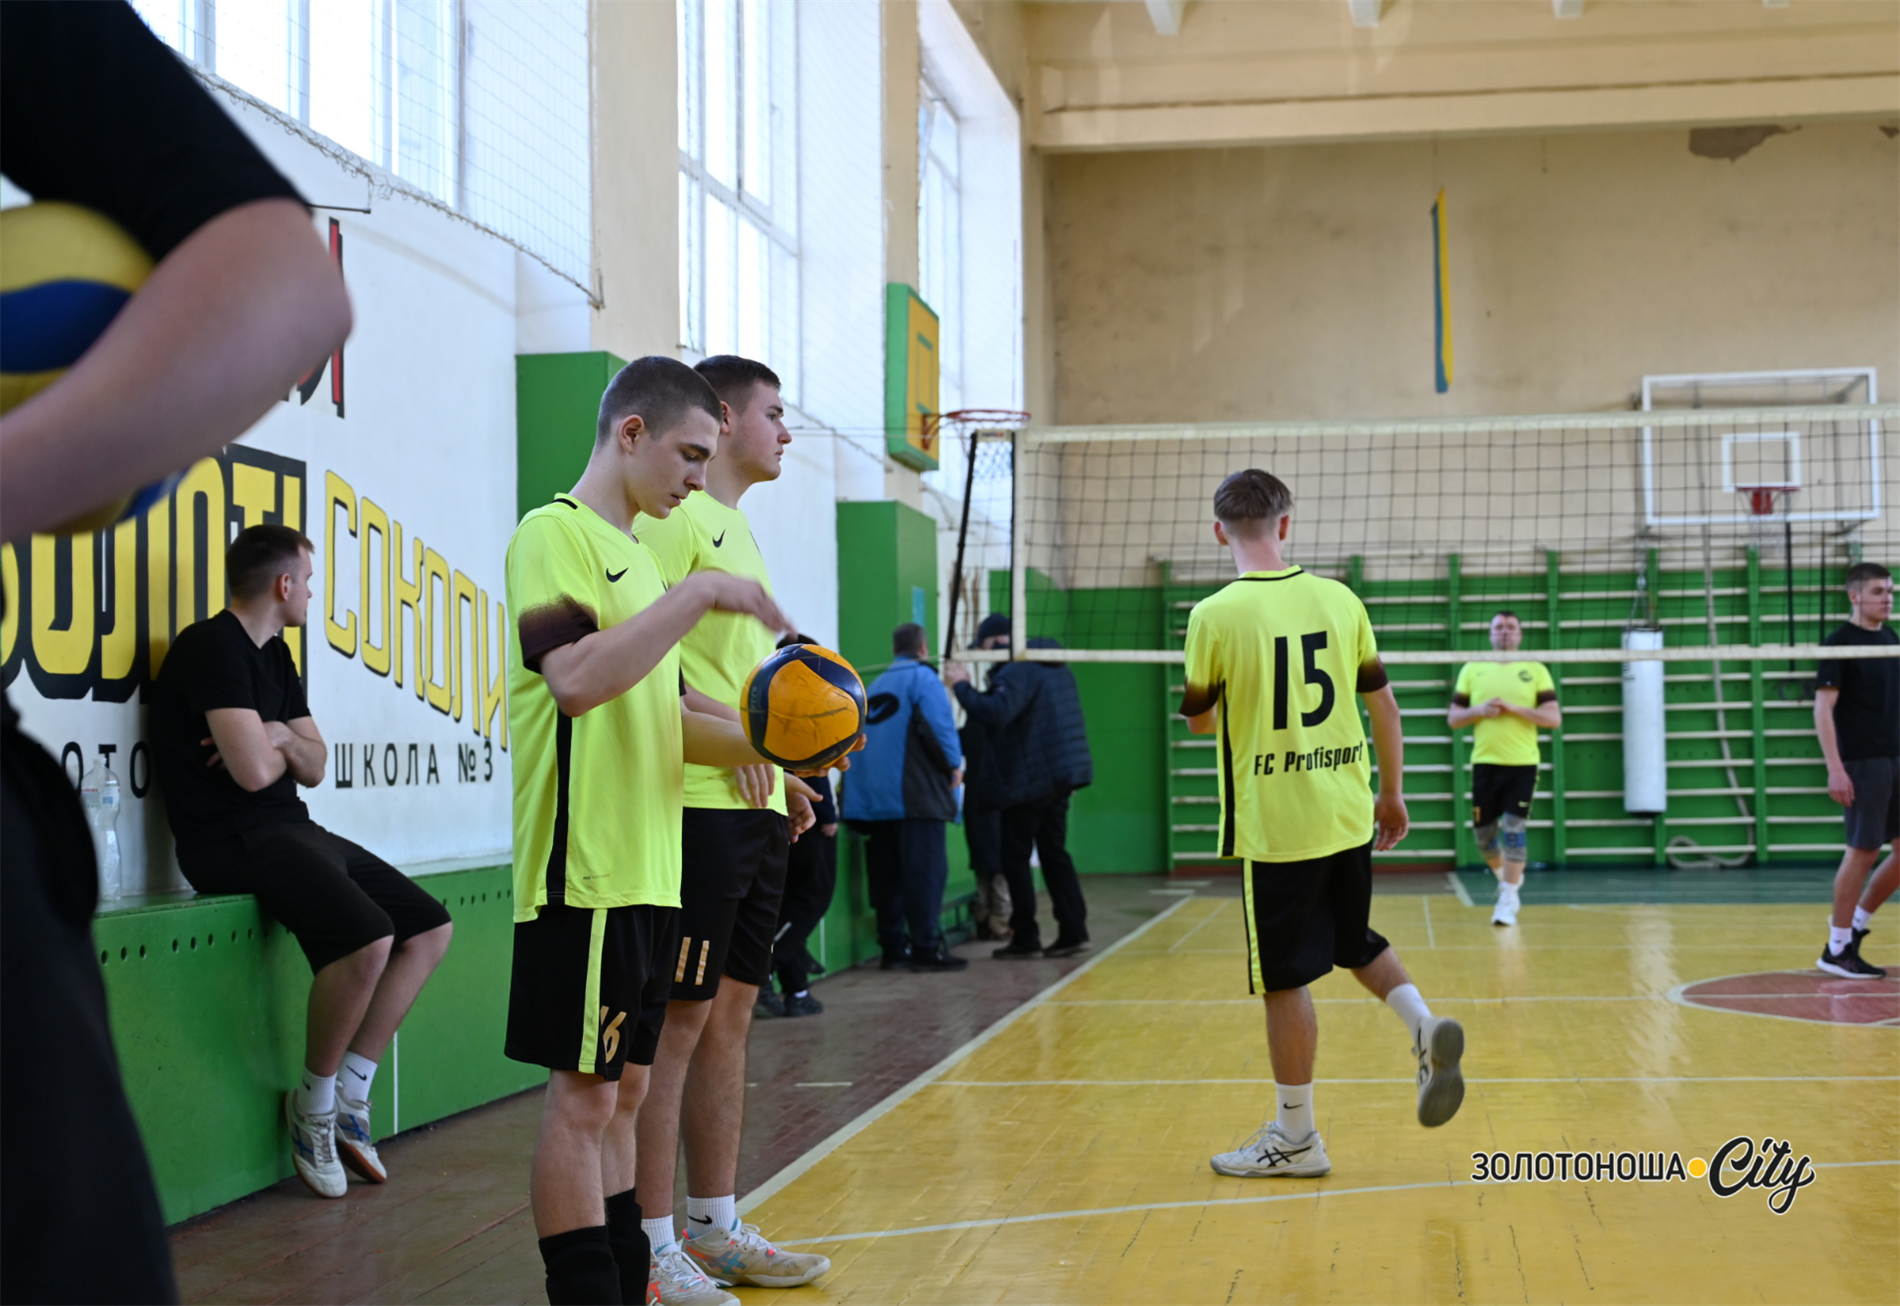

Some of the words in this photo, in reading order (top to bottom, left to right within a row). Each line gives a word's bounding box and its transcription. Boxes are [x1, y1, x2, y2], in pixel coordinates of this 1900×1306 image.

[324, 469, 507, 753] СОКОЛИ
[1273, 631, 1335, 731] 15
[335, 742, 440, 789] ШКОЛА
[1254, 750, 1276, 776] FC
[1283, 740, 1363, 773] Profisport
[674, 936, 710, 986] 11
